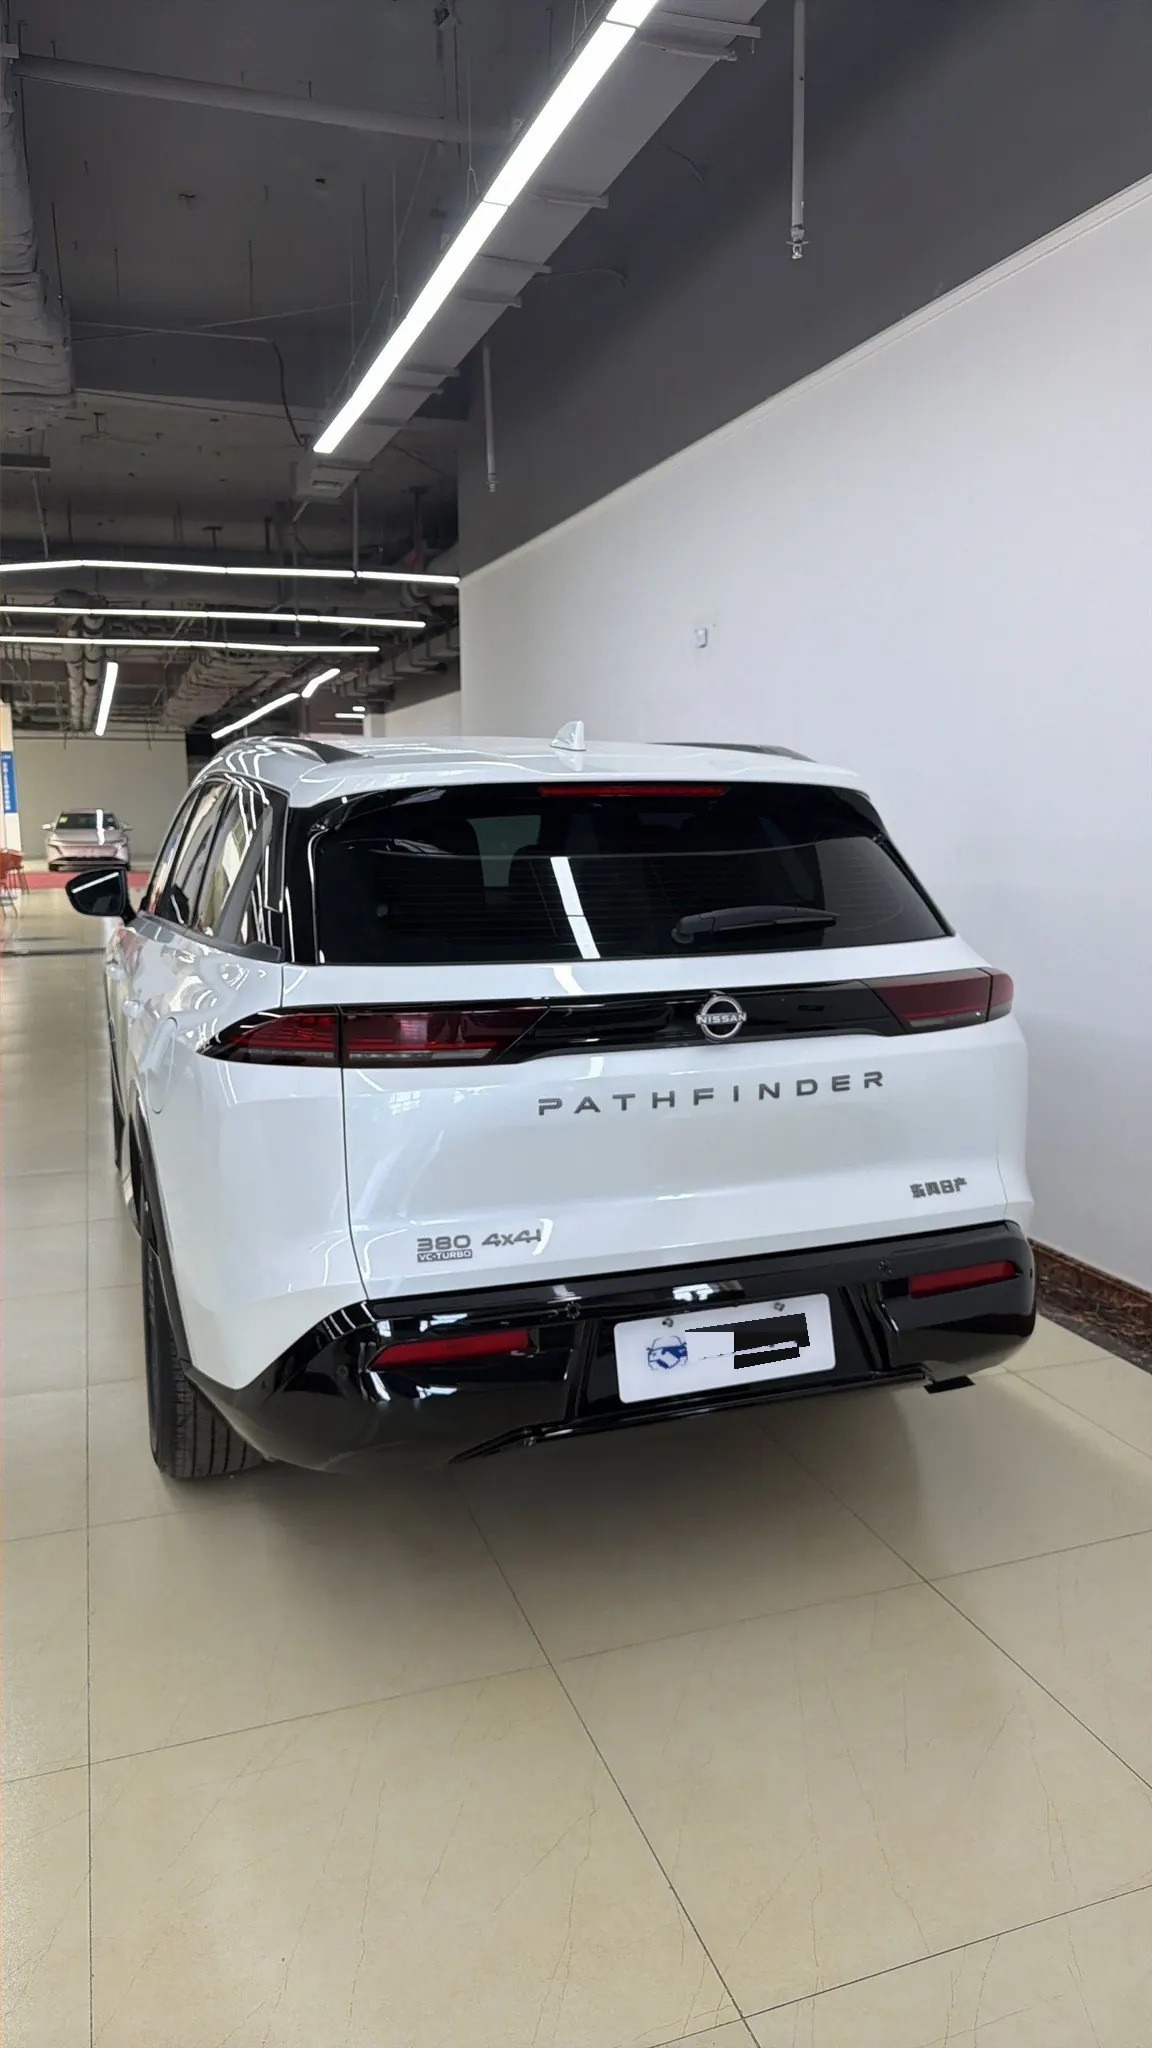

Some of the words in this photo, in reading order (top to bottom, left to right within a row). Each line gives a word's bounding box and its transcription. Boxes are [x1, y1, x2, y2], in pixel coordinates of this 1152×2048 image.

[696, 1012, 747, 1025] NISSAN
[537, 1071, 884, 1116] PATHFINDER
[417, 1234, 471, 1252] 380
[418, 1249, 472, 1262] VC-TURBO
